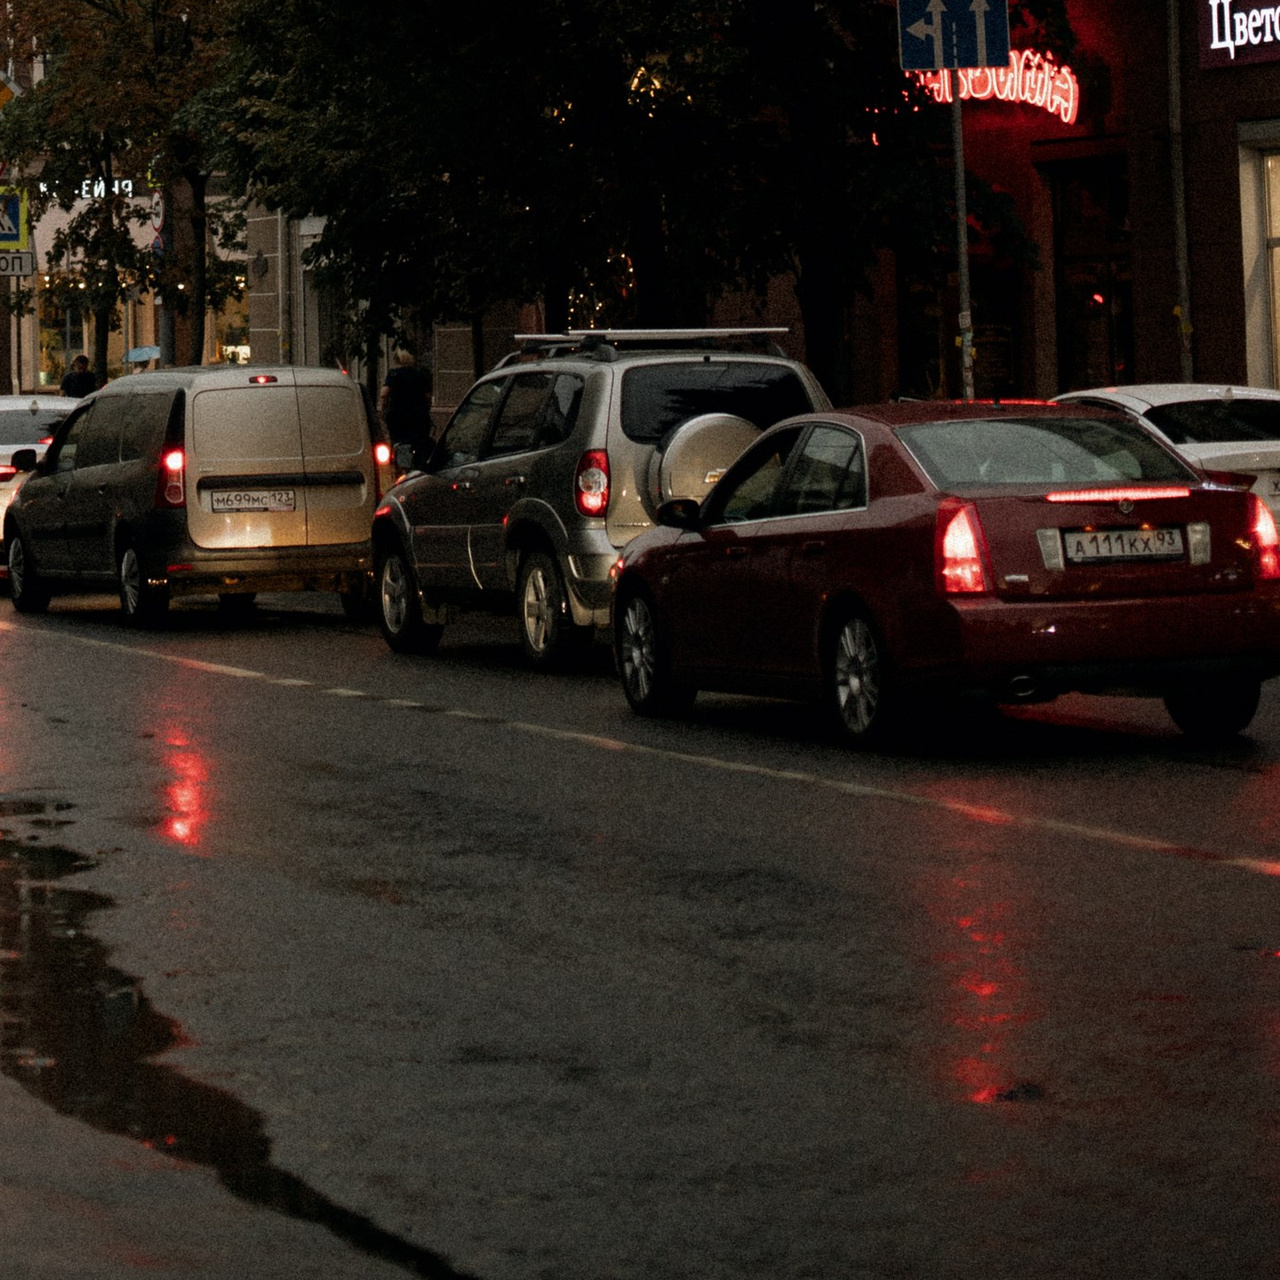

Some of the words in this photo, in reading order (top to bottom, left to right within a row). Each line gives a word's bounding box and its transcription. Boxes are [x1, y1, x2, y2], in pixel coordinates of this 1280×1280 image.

[216, 493, 269, 506] М699МС
[271, 492, 291, 503] 123
[1075, 534, 1153, 556] А111КХ
[1156, 530, 1176, 546] 93
